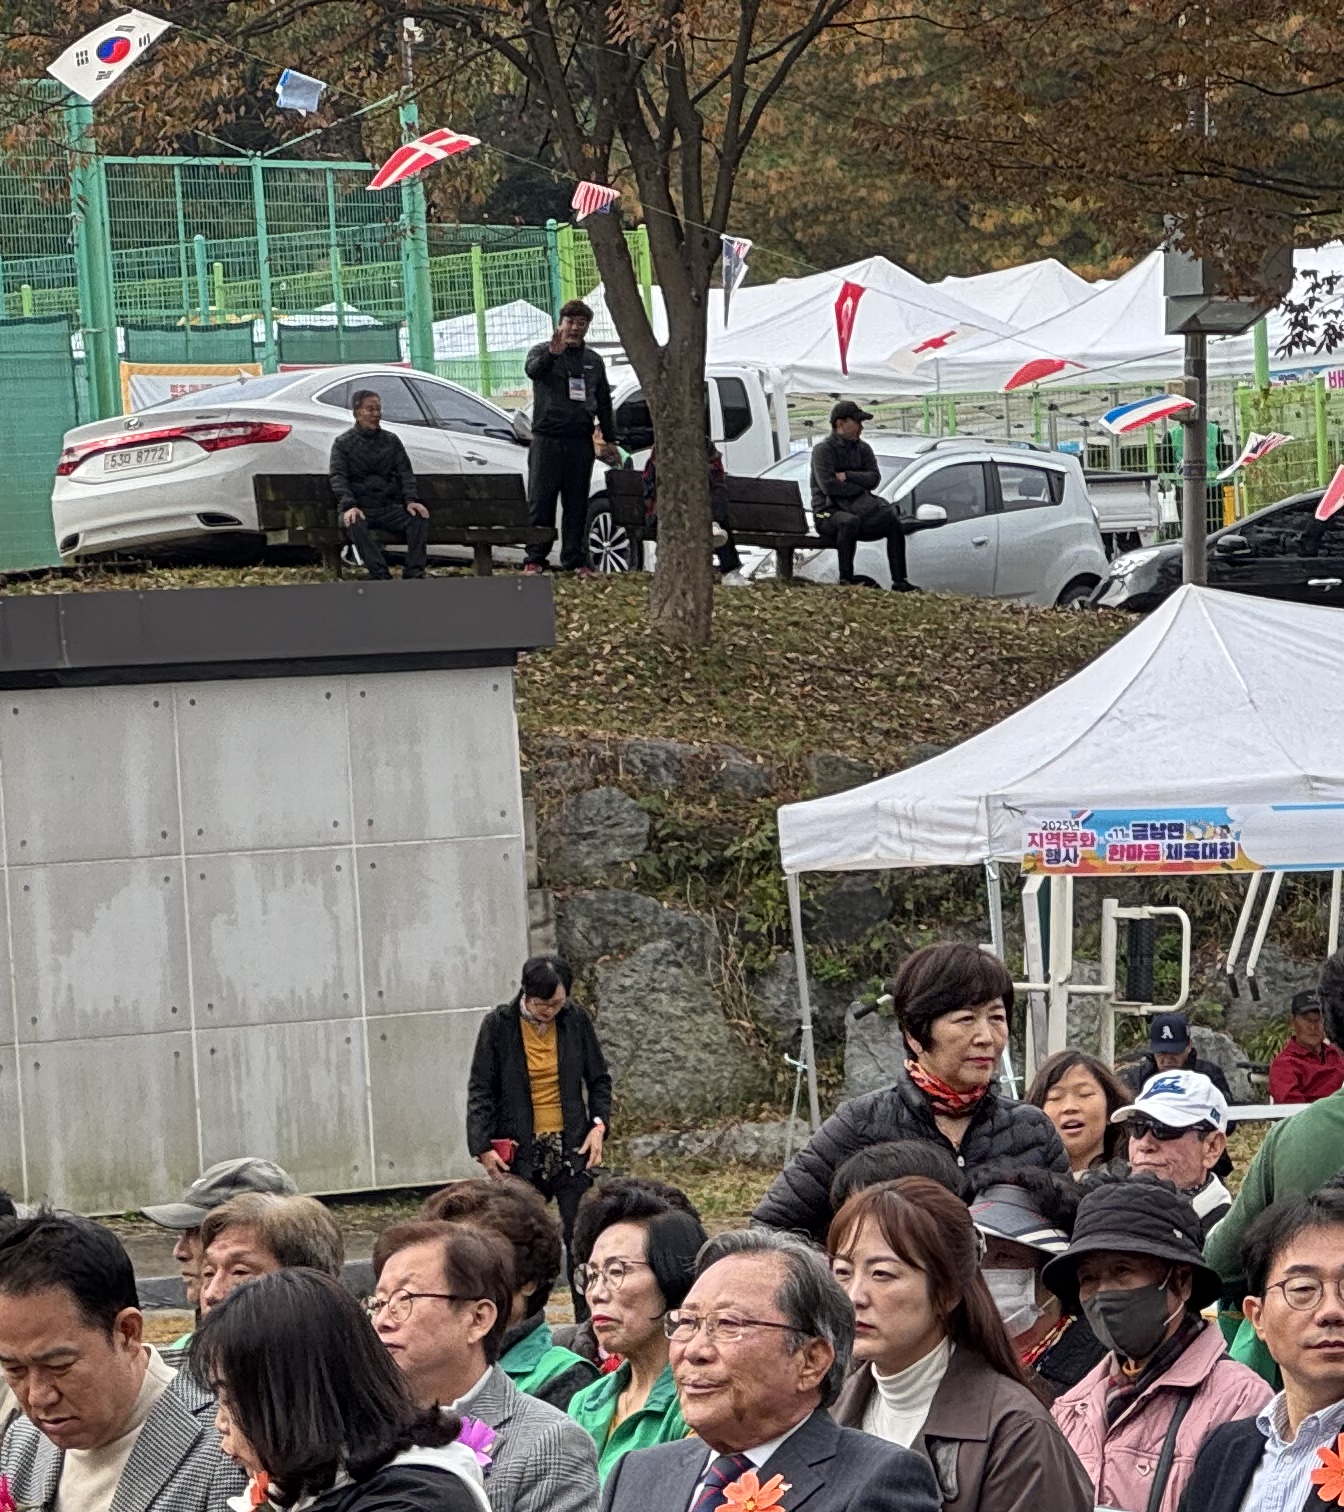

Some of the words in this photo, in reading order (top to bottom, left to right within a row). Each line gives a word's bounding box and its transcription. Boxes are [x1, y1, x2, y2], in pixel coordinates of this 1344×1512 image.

[1041, 820, 1080, 831] 2025년
[1131, 823, 1184, 841] 금남면
[1027, 831, 1095, 848] 지역문화
[1045, 848, 1080, 865] 행사
[1108, 843, 1161, 861] 한마음
[1166, 841, 1236, 861] 체육대회
